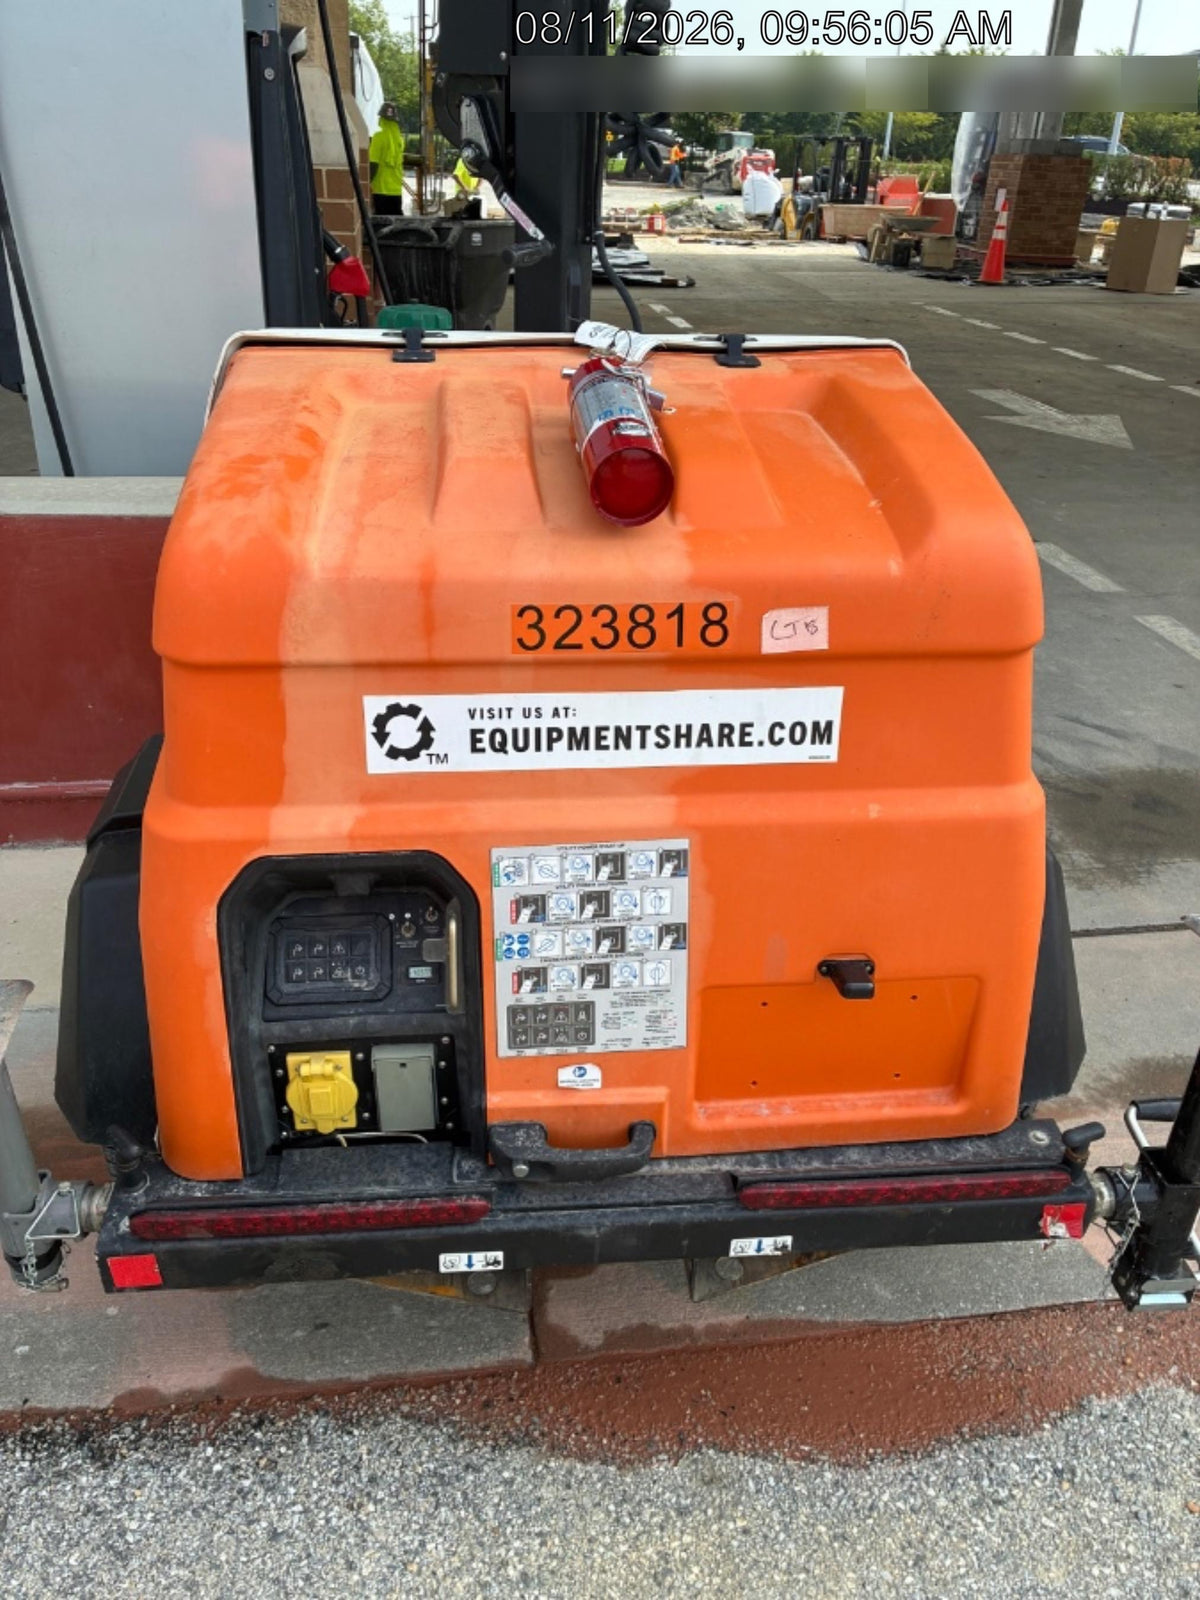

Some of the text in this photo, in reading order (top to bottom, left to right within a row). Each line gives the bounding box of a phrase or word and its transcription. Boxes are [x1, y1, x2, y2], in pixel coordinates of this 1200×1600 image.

[516, 602, 729, 652] 323818
[468, 705, 577, 721] VISIT US AT:
[469, 719, 833, 756] EQUIPMENTSHARE.COM
[426, 753, 449, 766] TM
